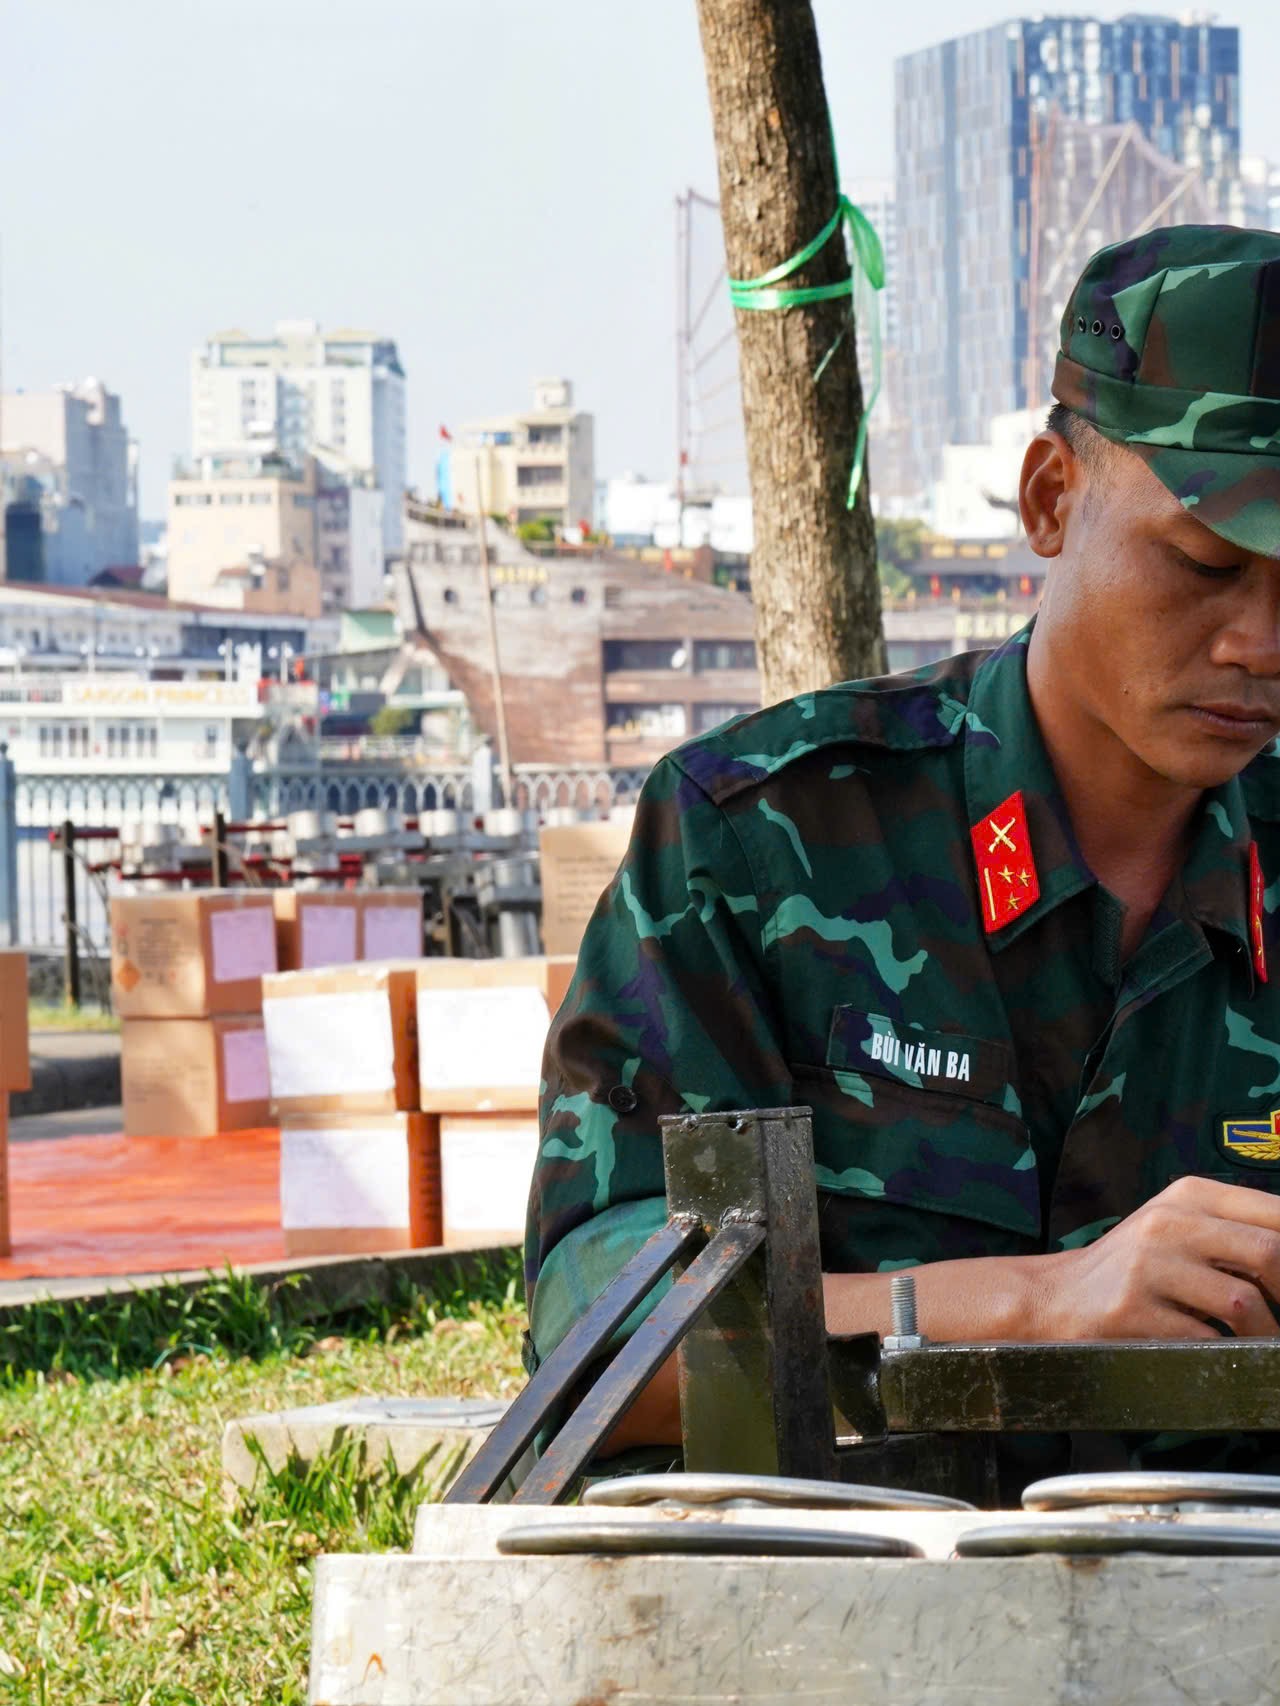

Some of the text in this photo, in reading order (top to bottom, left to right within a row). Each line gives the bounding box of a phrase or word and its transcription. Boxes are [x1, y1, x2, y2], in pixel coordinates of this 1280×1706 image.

[871, 1031, 970, 1082] BÙI VĂN BA
